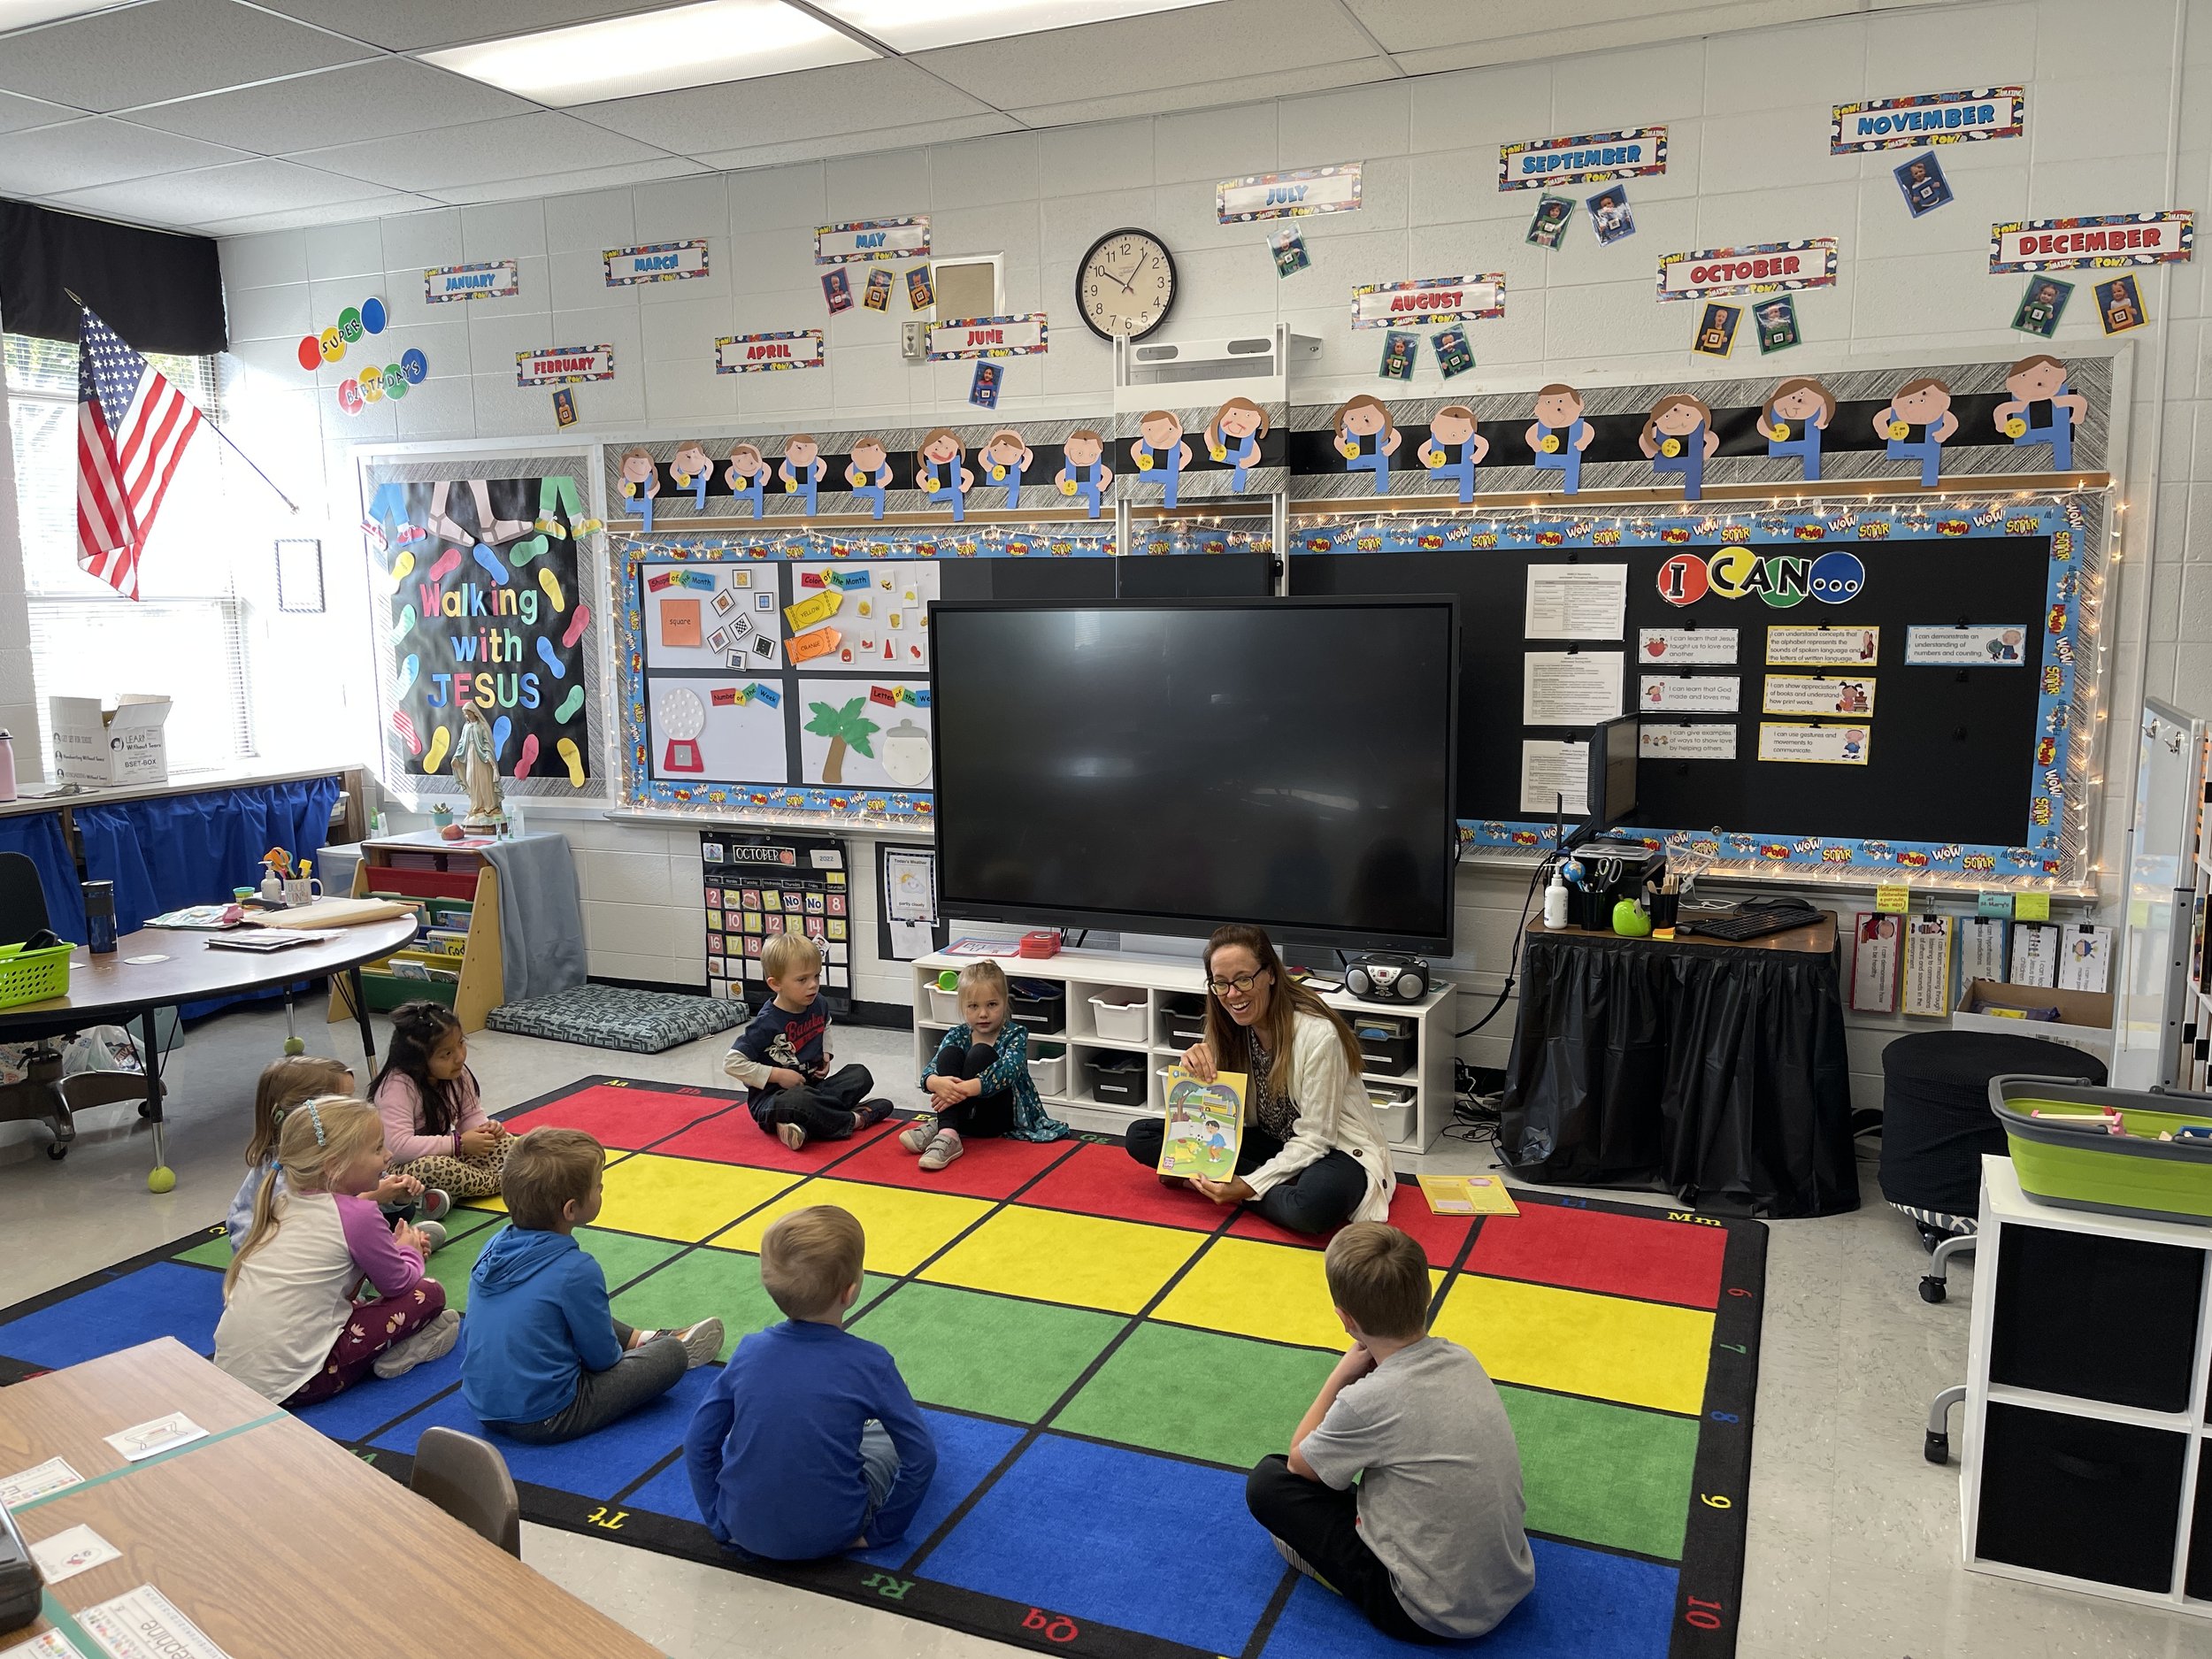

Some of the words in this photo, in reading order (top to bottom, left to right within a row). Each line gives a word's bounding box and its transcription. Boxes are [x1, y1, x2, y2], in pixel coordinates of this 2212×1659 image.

[1857, 104, 1994, 135] NOVEMBER
[1522, 144, 1642, 174] SEPTEMBER
[1265, 185, 1309, 205] JULY
[855, 232, 886, 250] MAY
[2018, 228, 2162, 256] DECEMBER
[1119, 243, 1132, 256] 12
[634, 253, 679, 272] MARCH
[1106, 251, 1117, 263] 11
[1151, 257, 1160, 269] 2
[1094, 265, 1105, 277] 10
[1690, 256, 1800, 284] OCTOBER
[445, 273, 495, 291] JANUARY
[1157, 277, 1164, 288] 3
[1090, 285, 1098, 296] 9
[1153, 296, 1161, 308] 4
[1390, 291, 1463, 312] AUGUST
[1095, 303, 1103, 315] 8
[1110, 315, 1117, 326] 7
[1125, 317, 1133, 329] 6
[1141, 311, 1148, 322] 5
[322, 319, 361, 353] SUPER
[966, 328, 1004, 347] JUNE
[746, 343, 792, 360] APRIL
[534, 357, 595, 375] FEBRUARY
[346, 361, 420, 403] BIRTHDAYS
[1972, 510, 2007, 527] WOW!
[1937, 522, 1971, 534] BOOM!
[651, 578, 670, 587] Shape
[681, 574, 691, 586] the
[692, 577, 711, 586] Month
[805, 576, 823, 585] Color
[824, 570, 831, 581] of
[833, 576, 844, 586] the
[846, 576, 867, 586] Month
[1669, 563, 1685, 598] I
[419, 580, 537, 626] Walking
[801, 605, 820, 618] YELLOW
[669, 618, 691, 626] square
[450, 627, 522, 663] with
[801, 641, 820, 652] ORANGE
[427, 672, 541, 709] JESUS
[746, 687, 757, 697] the
[760, 689, 777, 703] Week
[874, 690, 894, 701] Letter
[895, 688, 902, 697] of
[905, 694, 916, 703] the
[125, 759, 157, 768] BSET-BOX
[736, 848, 779, 861] OCTOBER
[710, 892, 718, 903] 2
[768, 894, 776, 906] 5
[783, 895, 801, 907] No
[806, 898, 822, 910] No
[832, 897, 841, 910] 8
[711, 914, 718, 926] 9
[728, 915, 741, 927] 10
[749, 916, 757, 928] 11
[768, 918, 780, 930] 12
[788, 918, 801, 931] 13
[809, 918, 821, 933] 14
[830, 924, 842, 935] 15
[710, 936, 721, 949] 16
[729, 938, 740, 950] 17
[748, 939, 758, 951] 18
[1079, 1133, 1112, 1145] Gg
[1667, 1210, 1723, 1227] Mm
[1727, 1286, 1754, 1298] 6
[1720, 1342, 1747, 1355] 7
[1710, 1409, 1740, 1424] 8
[1701, 1493, 1732, 1510] 9
[587, 1505, 631, 1532] Tt
[862, 1571, 918, 1601] Rr
[1685, 1594, 1722, 1630] 10
[1021, 1607, 1079, 1643] Qq
[141, 1619, 196, 1659] ephine
